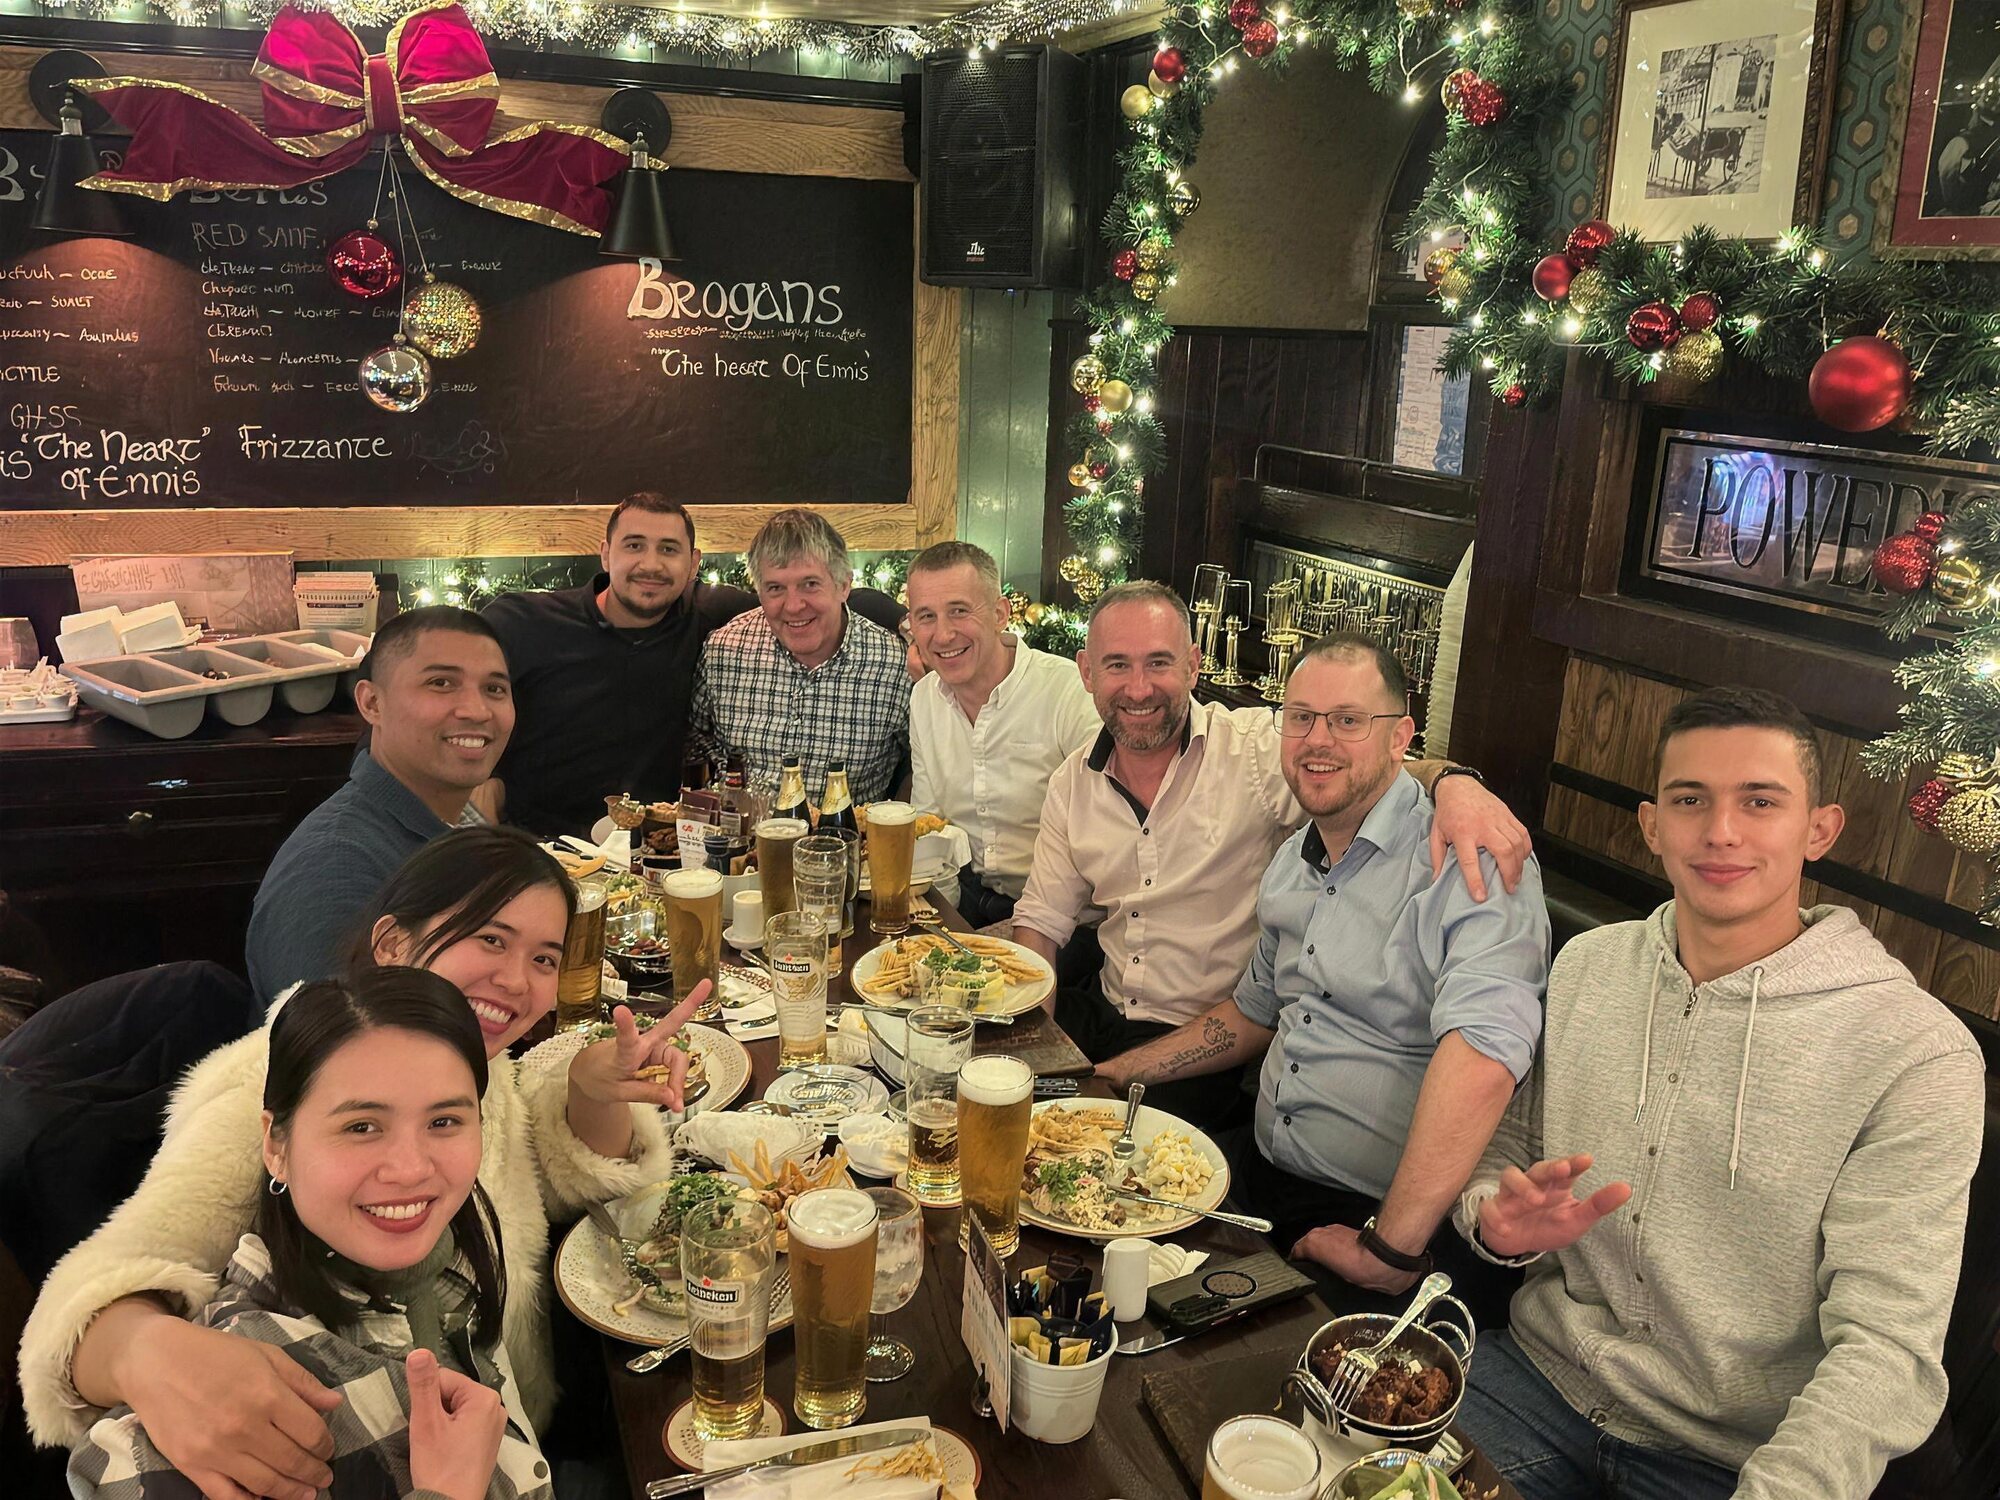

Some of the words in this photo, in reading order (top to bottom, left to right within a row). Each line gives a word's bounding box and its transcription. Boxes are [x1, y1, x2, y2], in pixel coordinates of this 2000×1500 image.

[192, 222, 247, 252] RED
[627, 257, 843, 331] Brogans
[661, 350, 704, 377] The
[715, 353, 770, 377] heart
[238, 424, 393, 460] Frizzante
[61, 467, 91, 500] of
[94, 465, 201, 499] Ennis
